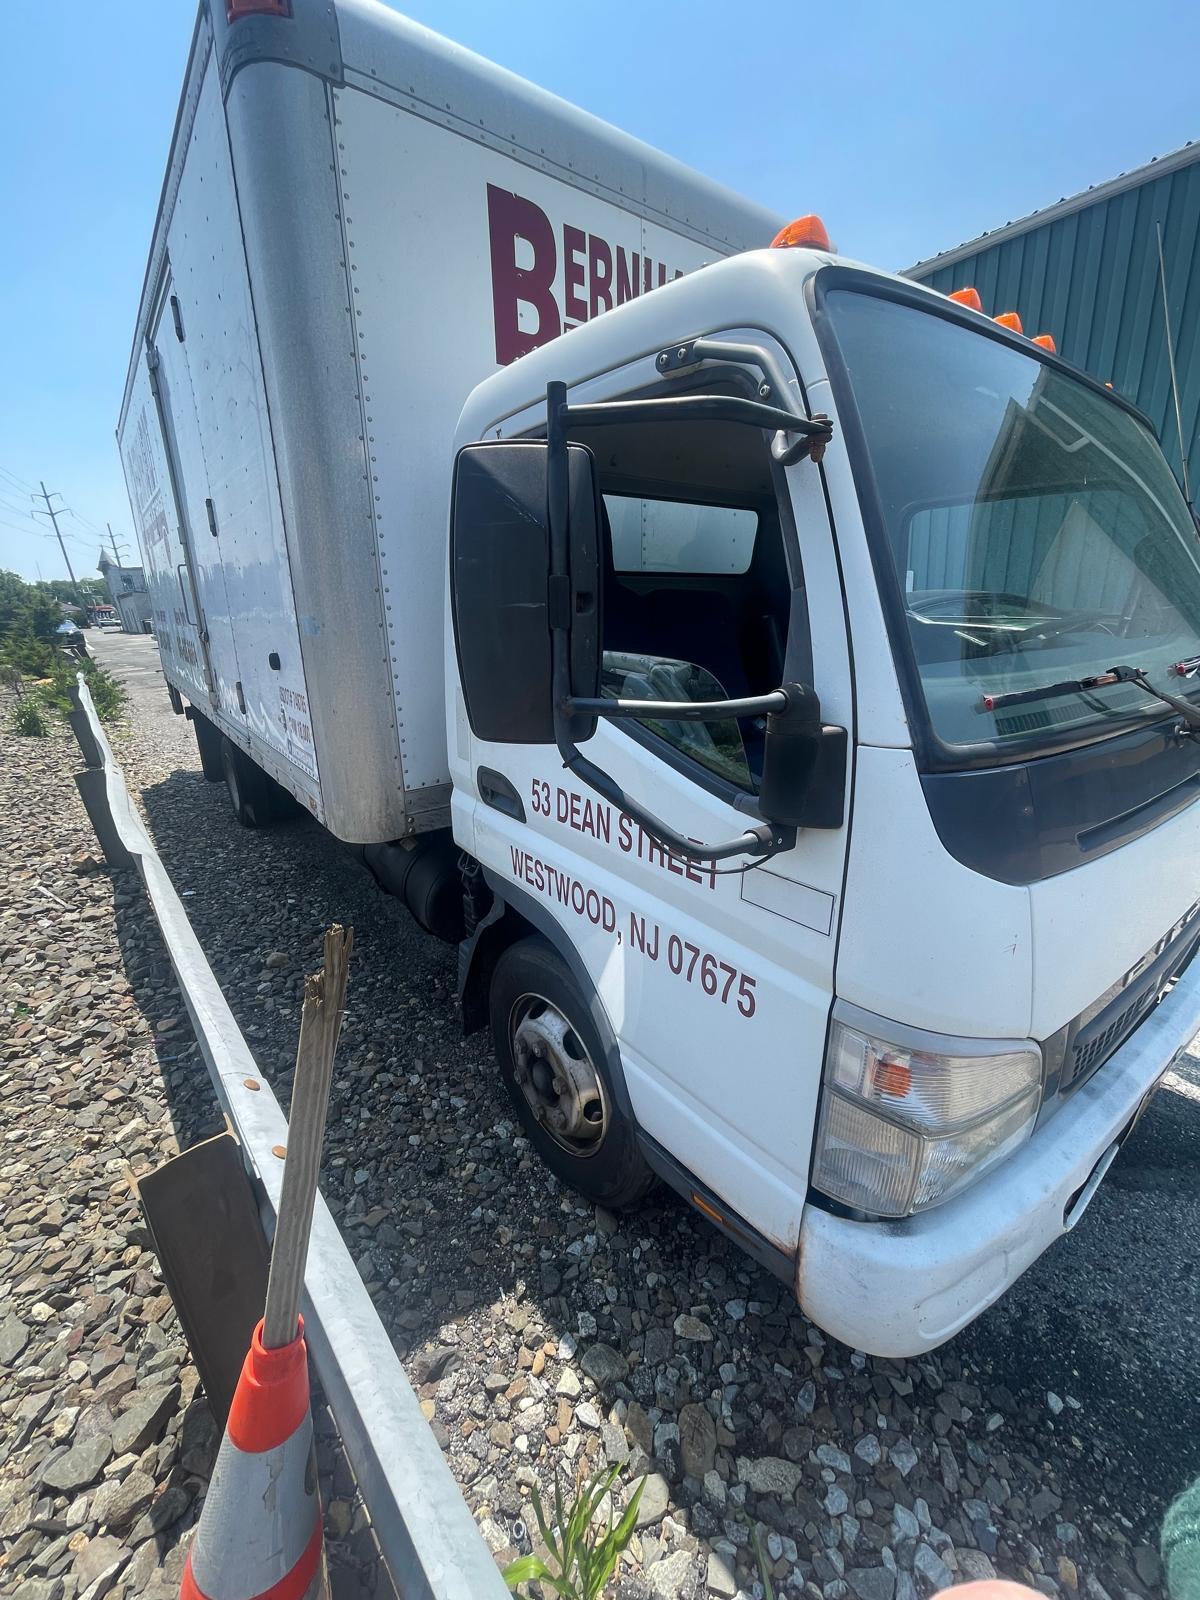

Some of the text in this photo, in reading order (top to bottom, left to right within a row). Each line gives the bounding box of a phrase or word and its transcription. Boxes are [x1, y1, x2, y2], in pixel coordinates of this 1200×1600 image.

[487, 182, 684, 366] BERN
[531, 778, 550, 817] 53
[556, 787, 611, 844] DEAN
[510, 845, 757, 1018] WESTWOOD, NJ 07675
